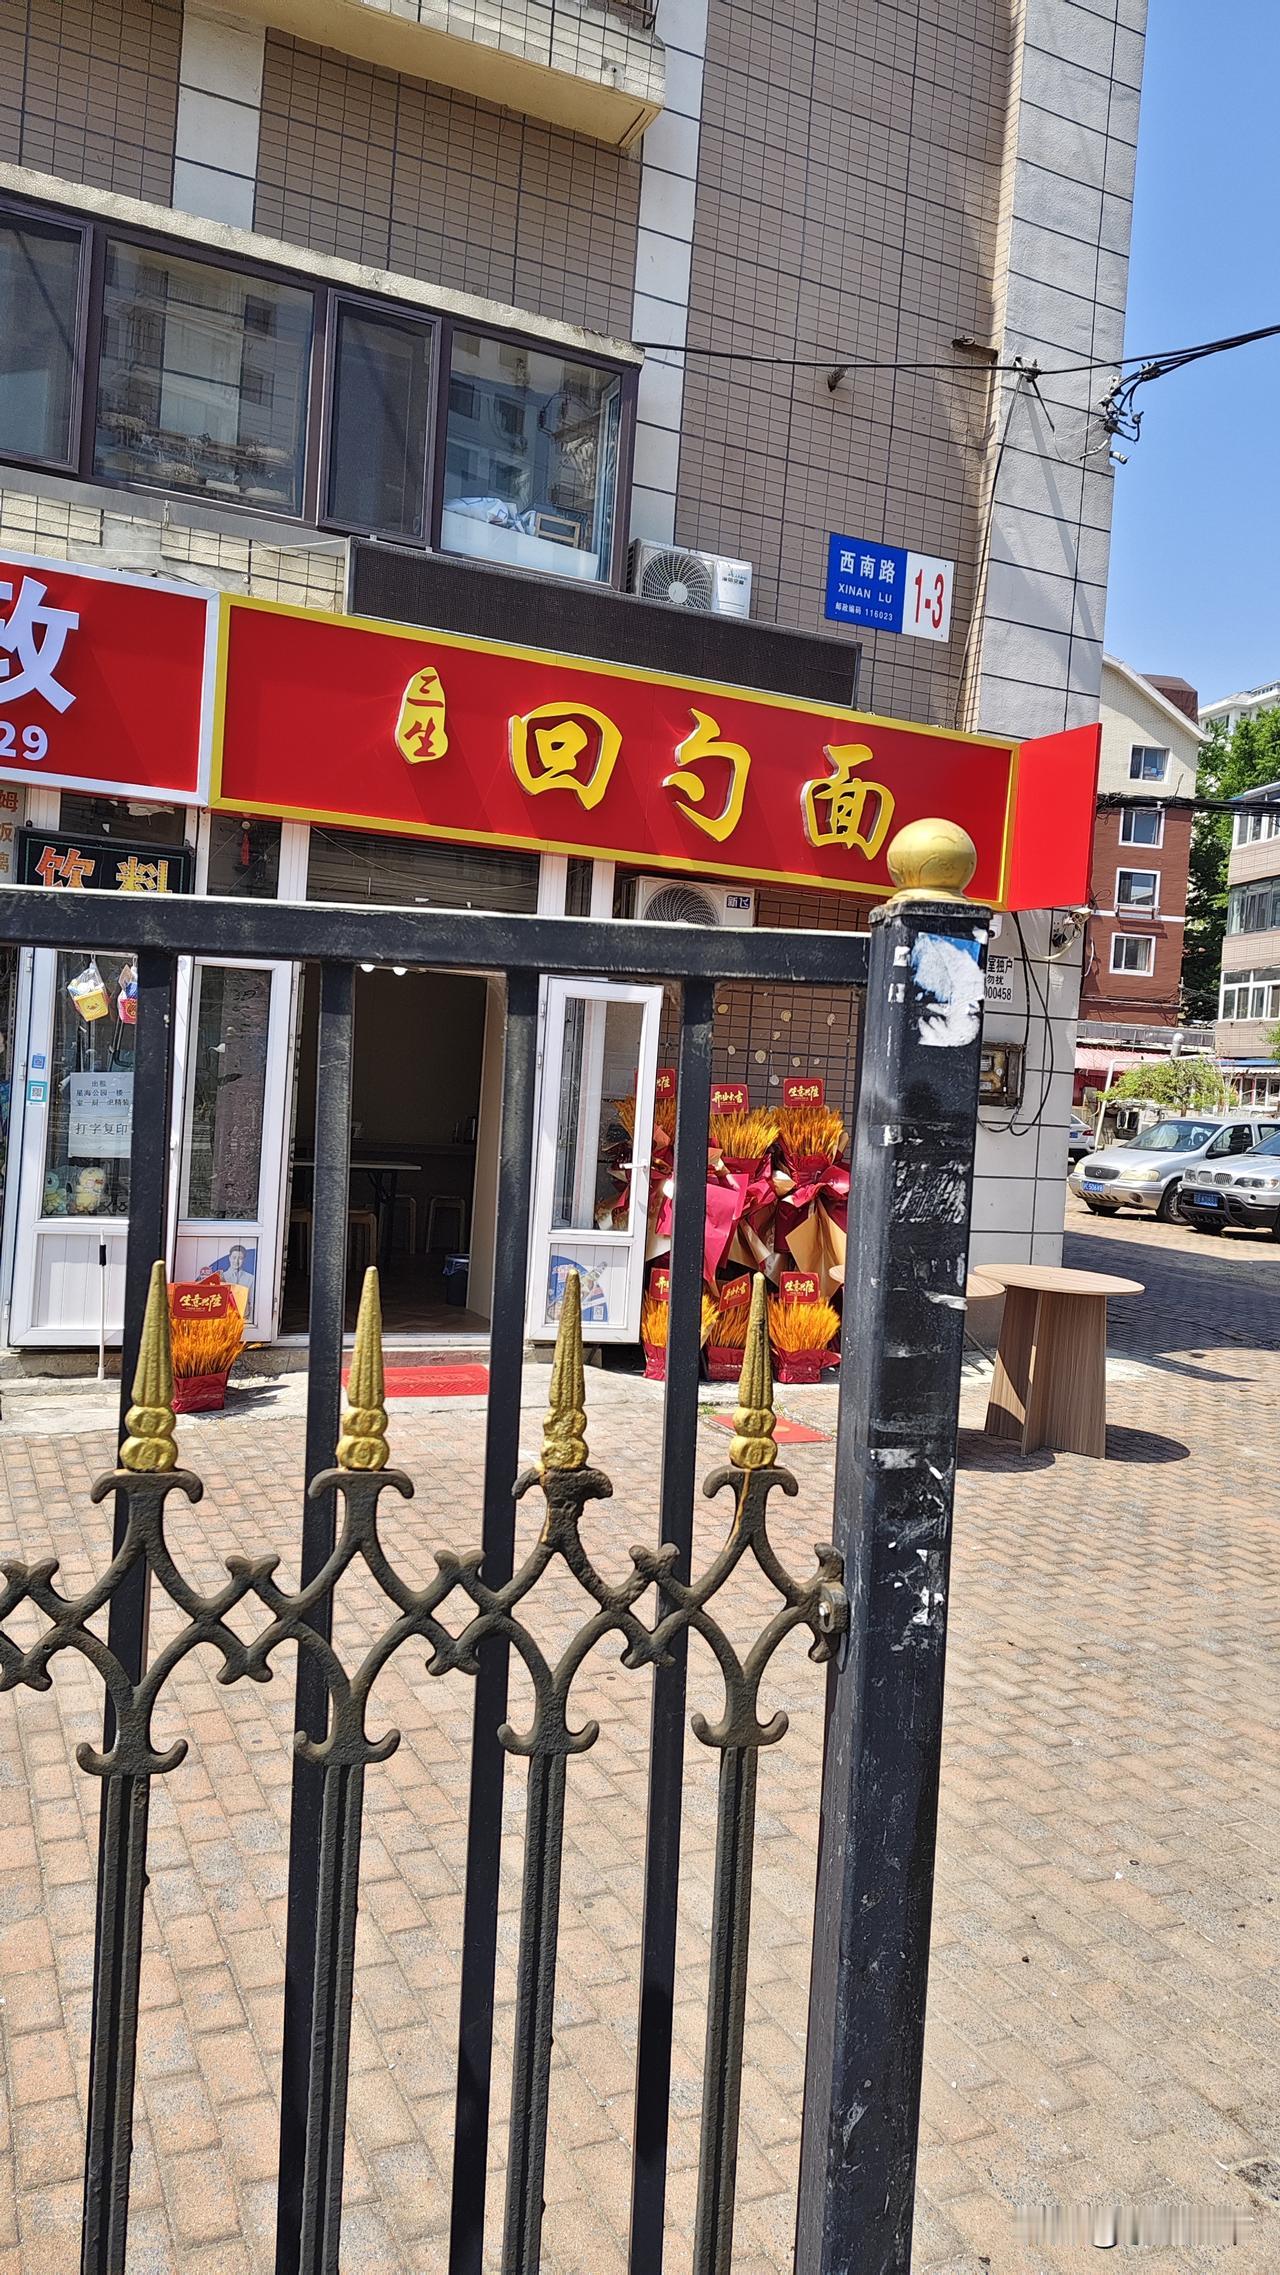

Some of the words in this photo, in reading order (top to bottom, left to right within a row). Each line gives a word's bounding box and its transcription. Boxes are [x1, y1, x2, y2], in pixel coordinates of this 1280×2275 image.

[839, 550, 895, 584] 西南路
[838, 583, 871, 599] XINAN
[878, 594, 892, 604] LU
[914, 569, 945, 629] 1-3
[835, 601, 862, 616] 邮政编码
[865, 609, 893, 621] 116023
[508, 701, 895, 861] 回勺面
[35, 845, 172, 893] 饮料
[985, 974, 1004, 985] 勿扰
[75, 1122, 128, 1136] 打字复印
